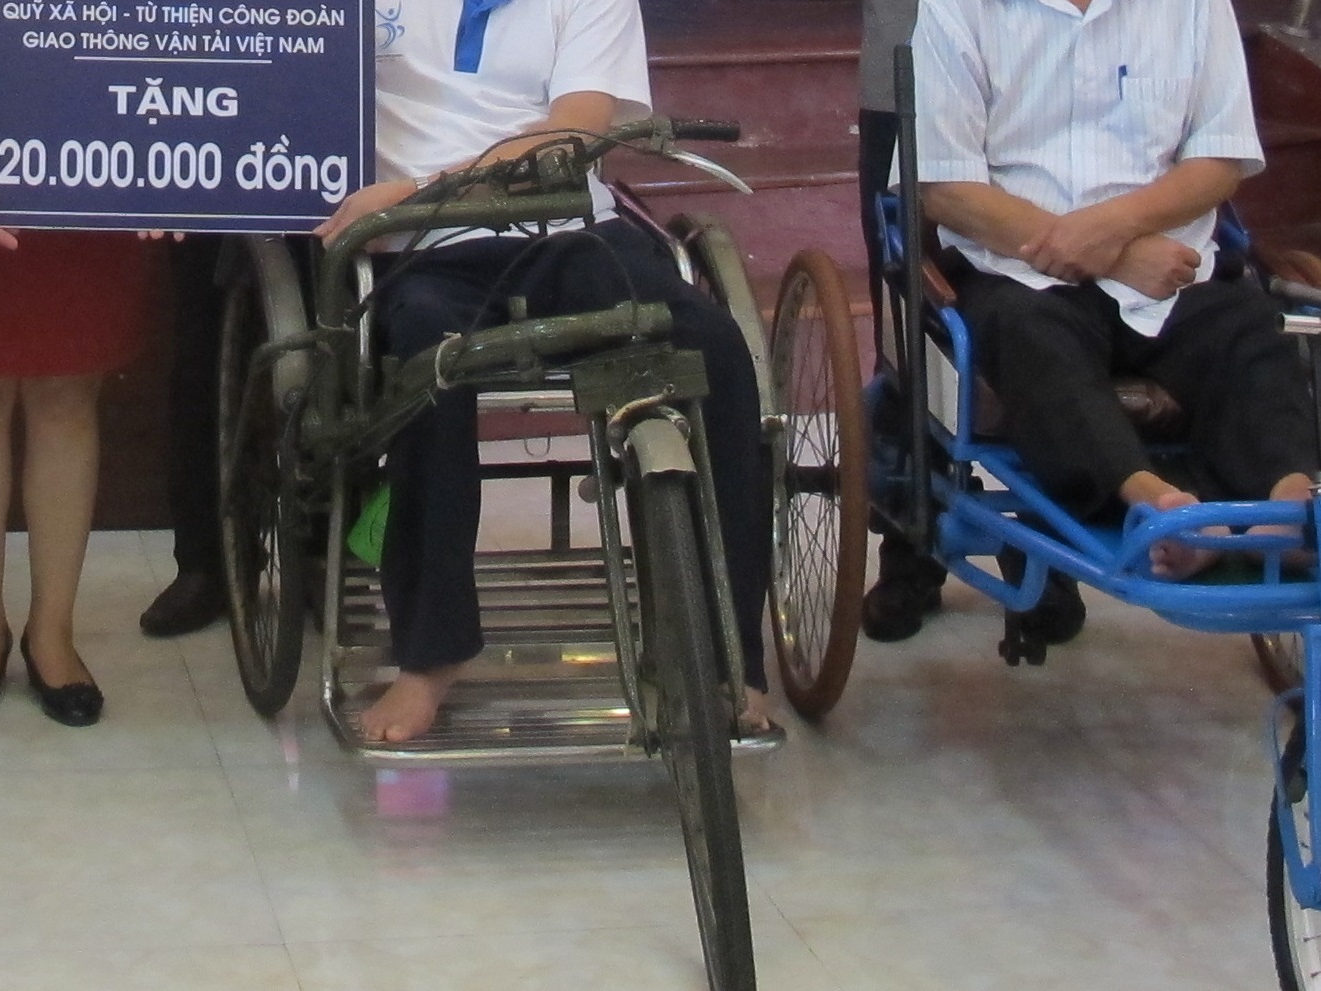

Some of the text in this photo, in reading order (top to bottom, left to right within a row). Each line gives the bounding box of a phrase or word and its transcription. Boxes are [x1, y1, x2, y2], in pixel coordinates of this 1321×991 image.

[2, 0, 45, 20] QUỸ
[49, 0, 77, 21] XÃ
[82, 1, 117, 25] HỘI
[136, 1, 158, 23] TỪ
[162, 2, 213, 27] THIỆN
[218, 4, 281, 25] CÔNG
[286, 4, 345, 26] ĐOÀN
[22, 29, 325, 56] GIAO THÔNG VẬN TẢI VIỆT NAM
[108, 77, 239, 125] TẶNG
[235, 134, 349, 203] đồng
